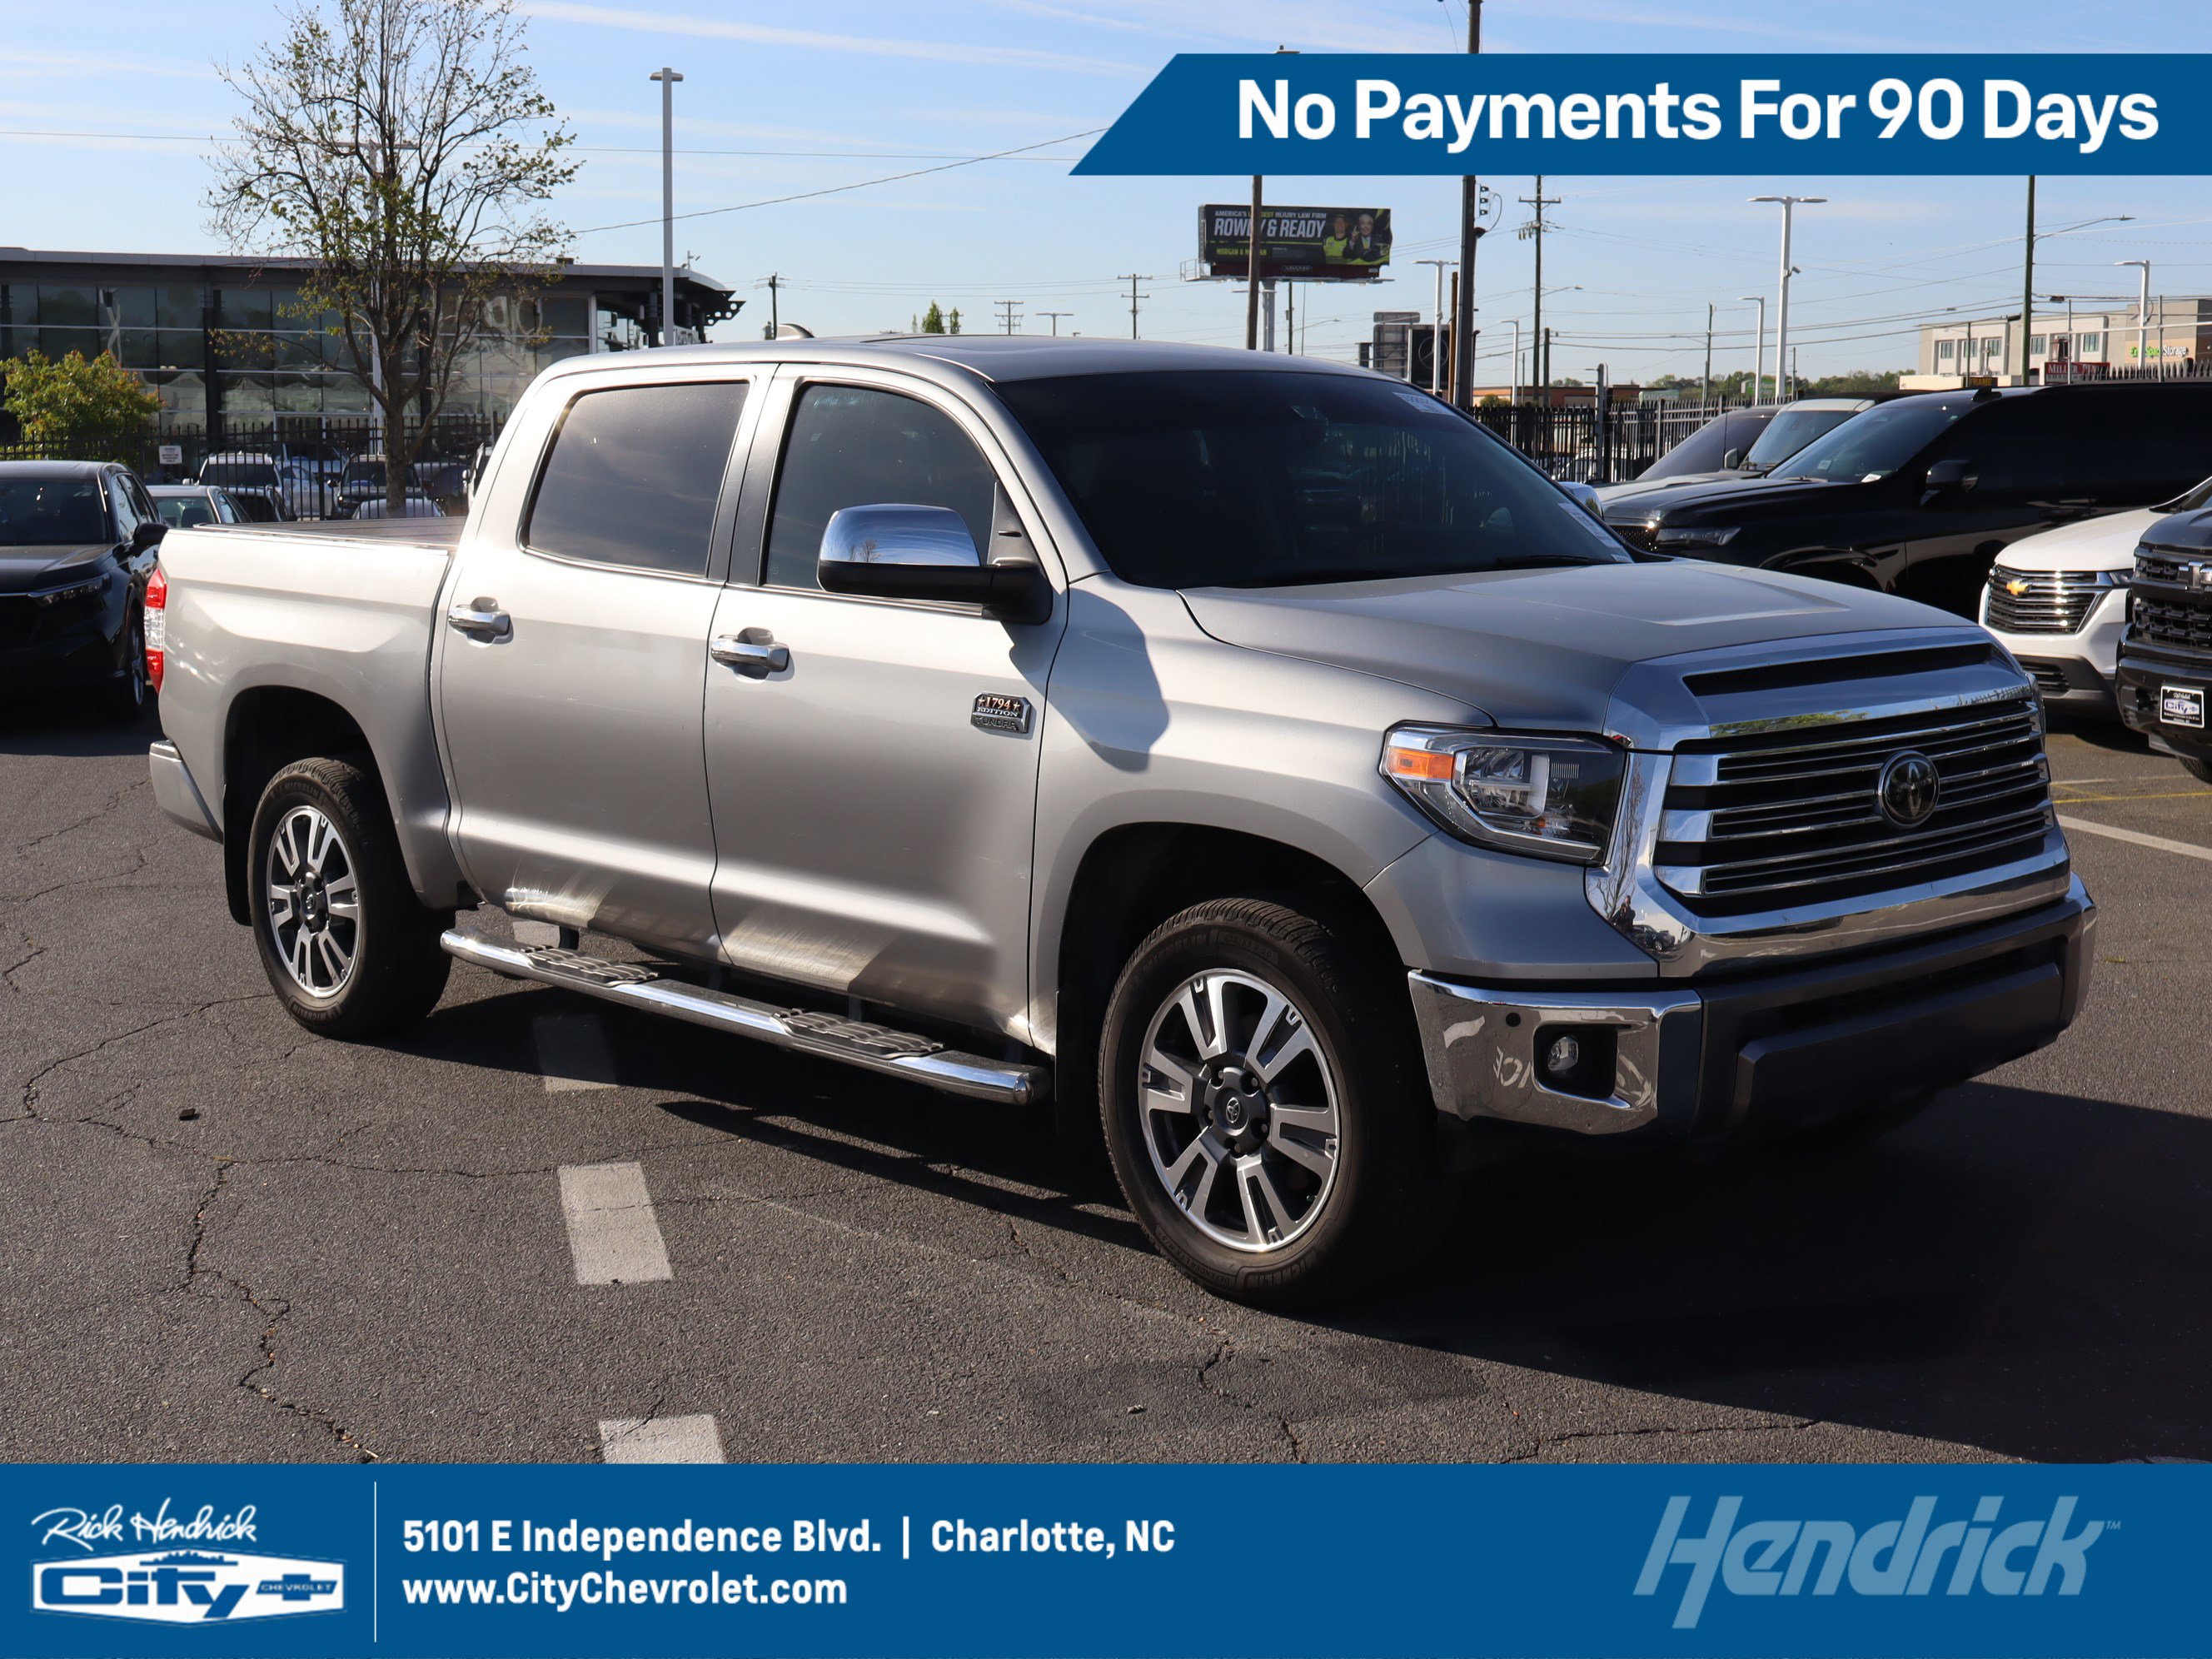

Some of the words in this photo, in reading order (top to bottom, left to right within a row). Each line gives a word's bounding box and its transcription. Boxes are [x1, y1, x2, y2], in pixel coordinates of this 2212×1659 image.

[1267, 219, 1278, 237] &
[1279, 219, 1326, 238] READY
[2163, 345, 2186, 356] Storage
[986, 696, 1011, 710] 1794
[977, 707, 1018, 717] EDITION
[975, 716, 1017, 730] TUNDRA
